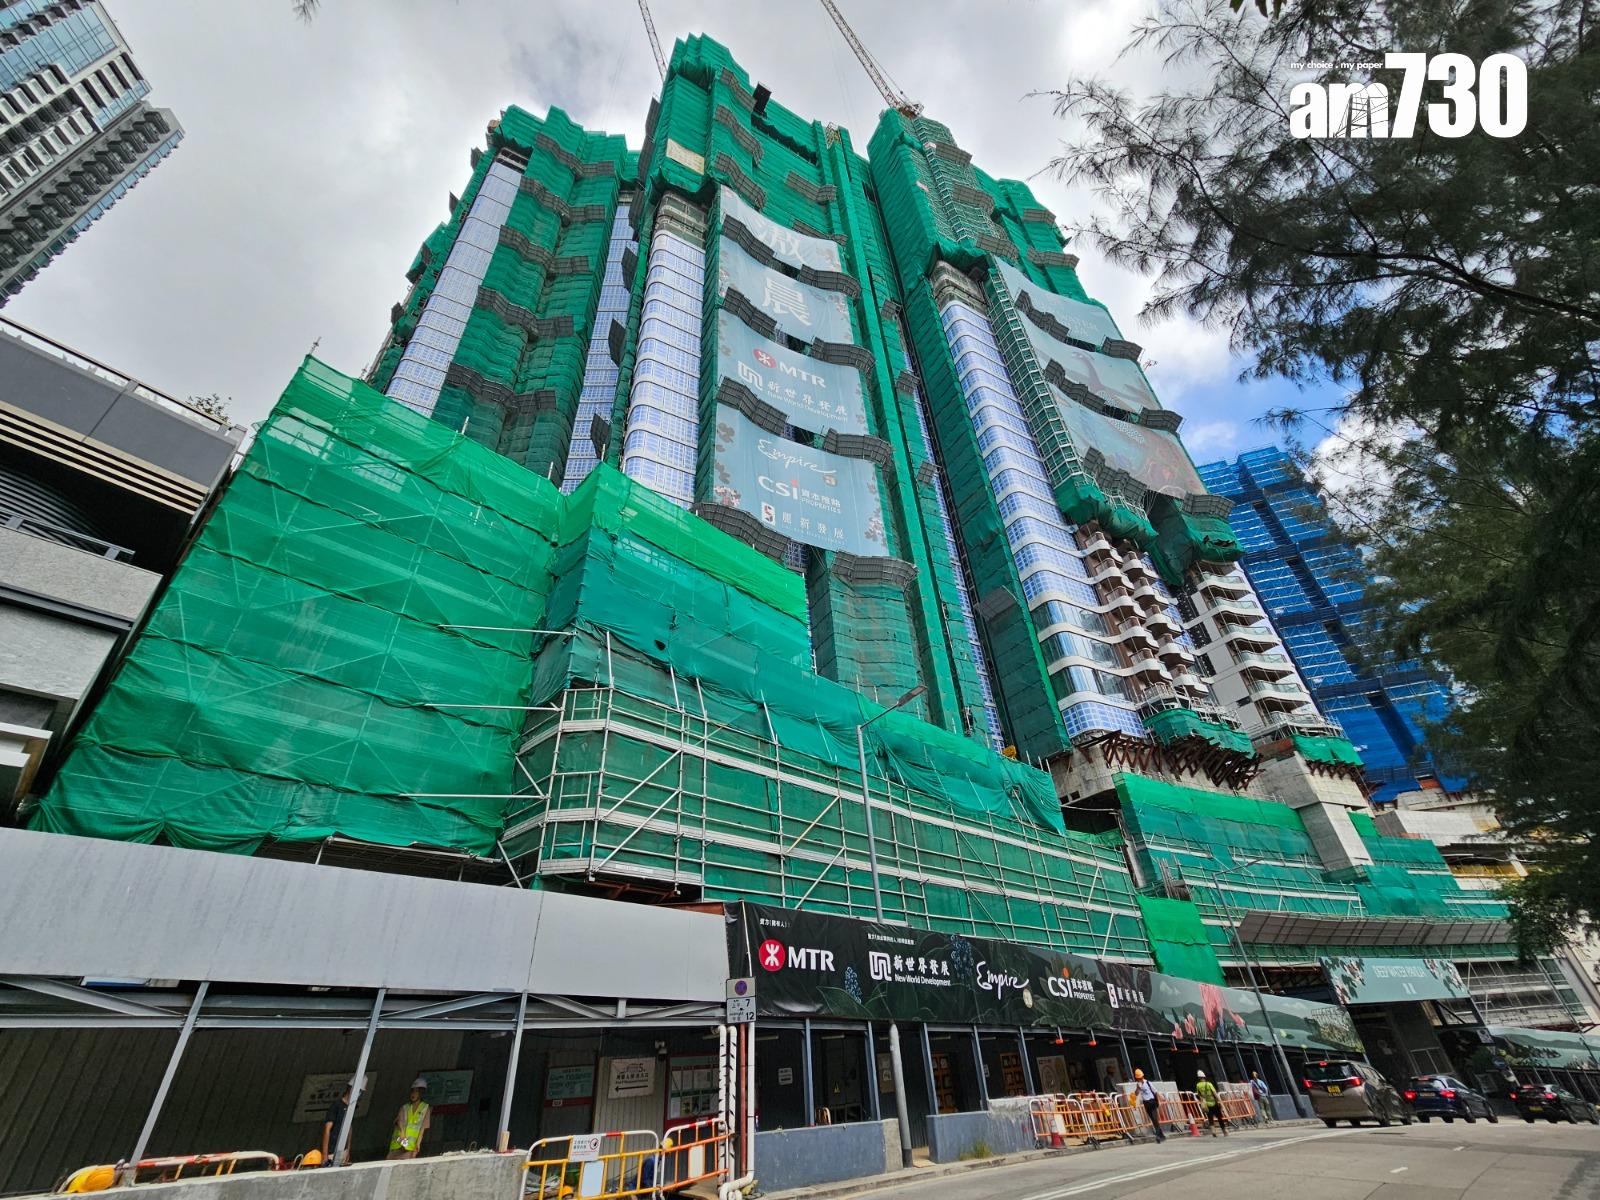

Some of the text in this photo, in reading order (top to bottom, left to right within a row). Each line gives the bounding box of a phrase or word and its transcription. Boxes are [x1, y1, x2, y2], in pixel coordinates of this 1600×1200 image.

[780, 361, 827, 388] MTR
[758, 438, 837, 474] Empire
[788, 946, 835, 972] MTR
[895, 973, 951, 987] New World Development
[976, 961, 1029, 999] Empire
[745, 998, 751, 1007] 7
[745, 1011, 755, 1020] 12
